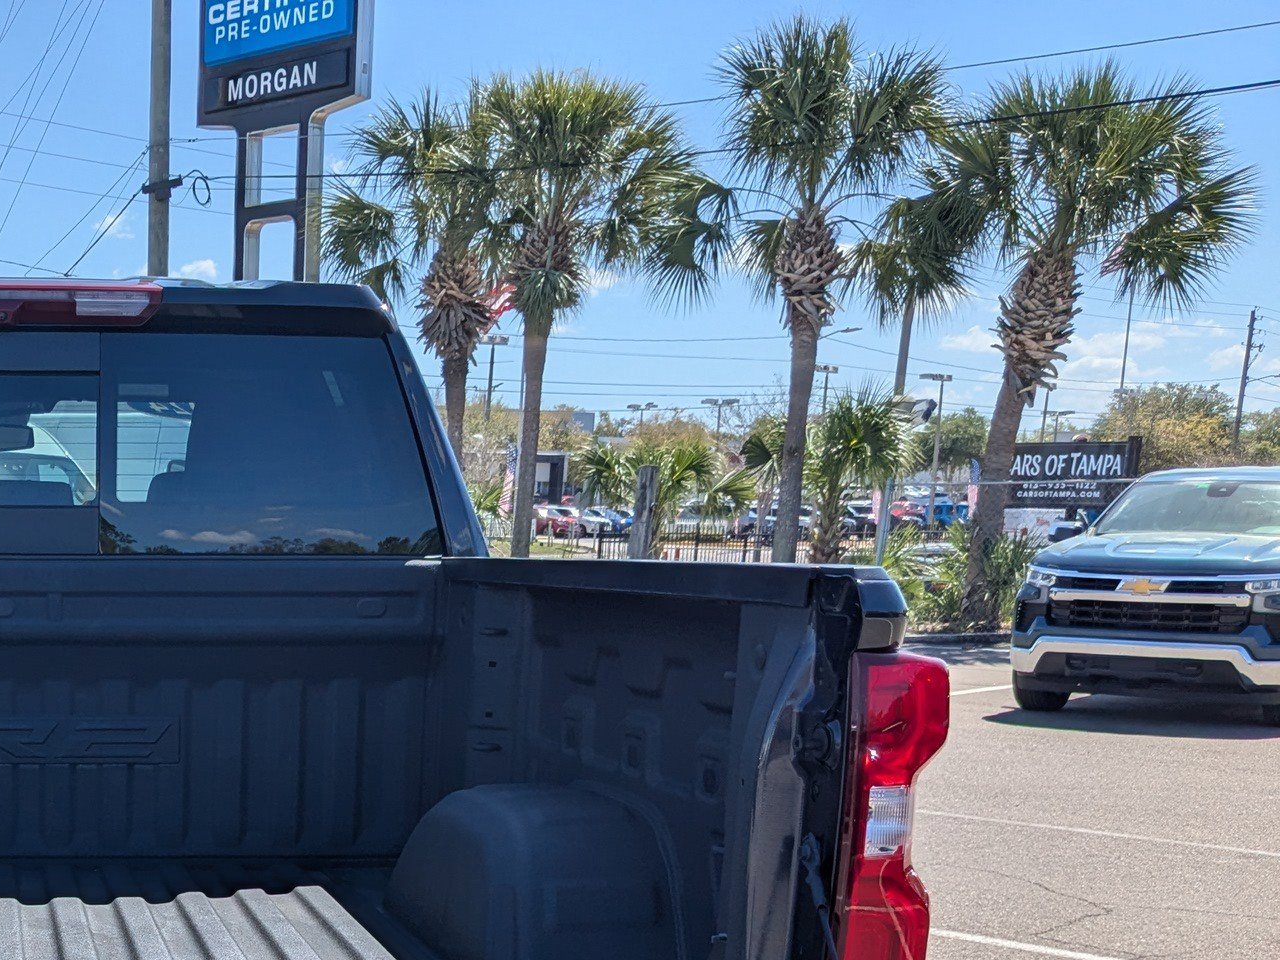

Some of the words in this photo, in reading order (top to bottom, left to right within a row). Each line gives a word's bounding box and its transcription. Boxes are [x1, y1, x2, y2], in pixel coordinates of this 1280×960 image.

[215, 0, 334, 44] PRE-OWNED
[228, 61, 317, 101] MORGAN
[1010, 454, 1042, 476] ARS
[1045, 454, 1069, 476] OF
[1071, 452, 1122, 476] TAMPA
[1016, 490, 1100, 498] CARSOFTAMPA.COM
